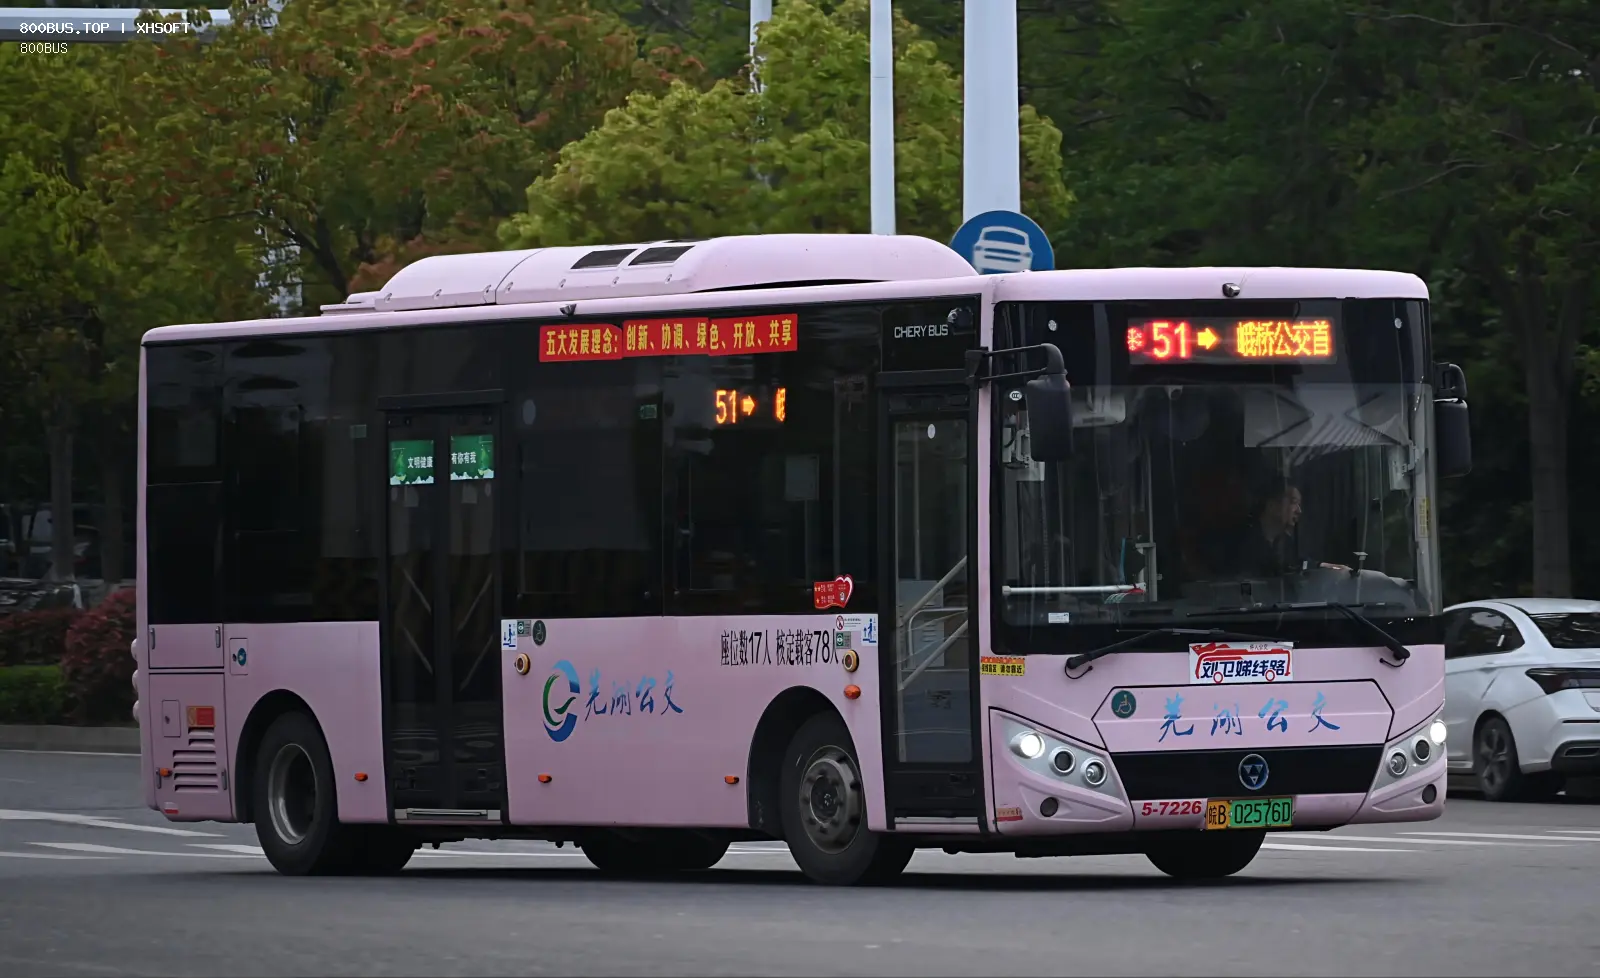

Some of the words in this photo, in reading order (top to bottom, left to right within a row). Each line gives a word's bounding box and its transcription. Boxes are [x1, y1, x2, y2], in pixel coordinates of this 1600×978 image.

[894, 325, 927, 338] CHERY
[928, 324, 949, 337] BUS
[1152, 321, 1188, 358] 51
[716, 389, 737, 424] 51
[451, 451, 477, 465] 有你有我
[585, 666, 684, 721] 芜湖公交
[1158, 691, 1341, 742] 芜湖公交
[1141, 800, 1202, 816] 5-7226
